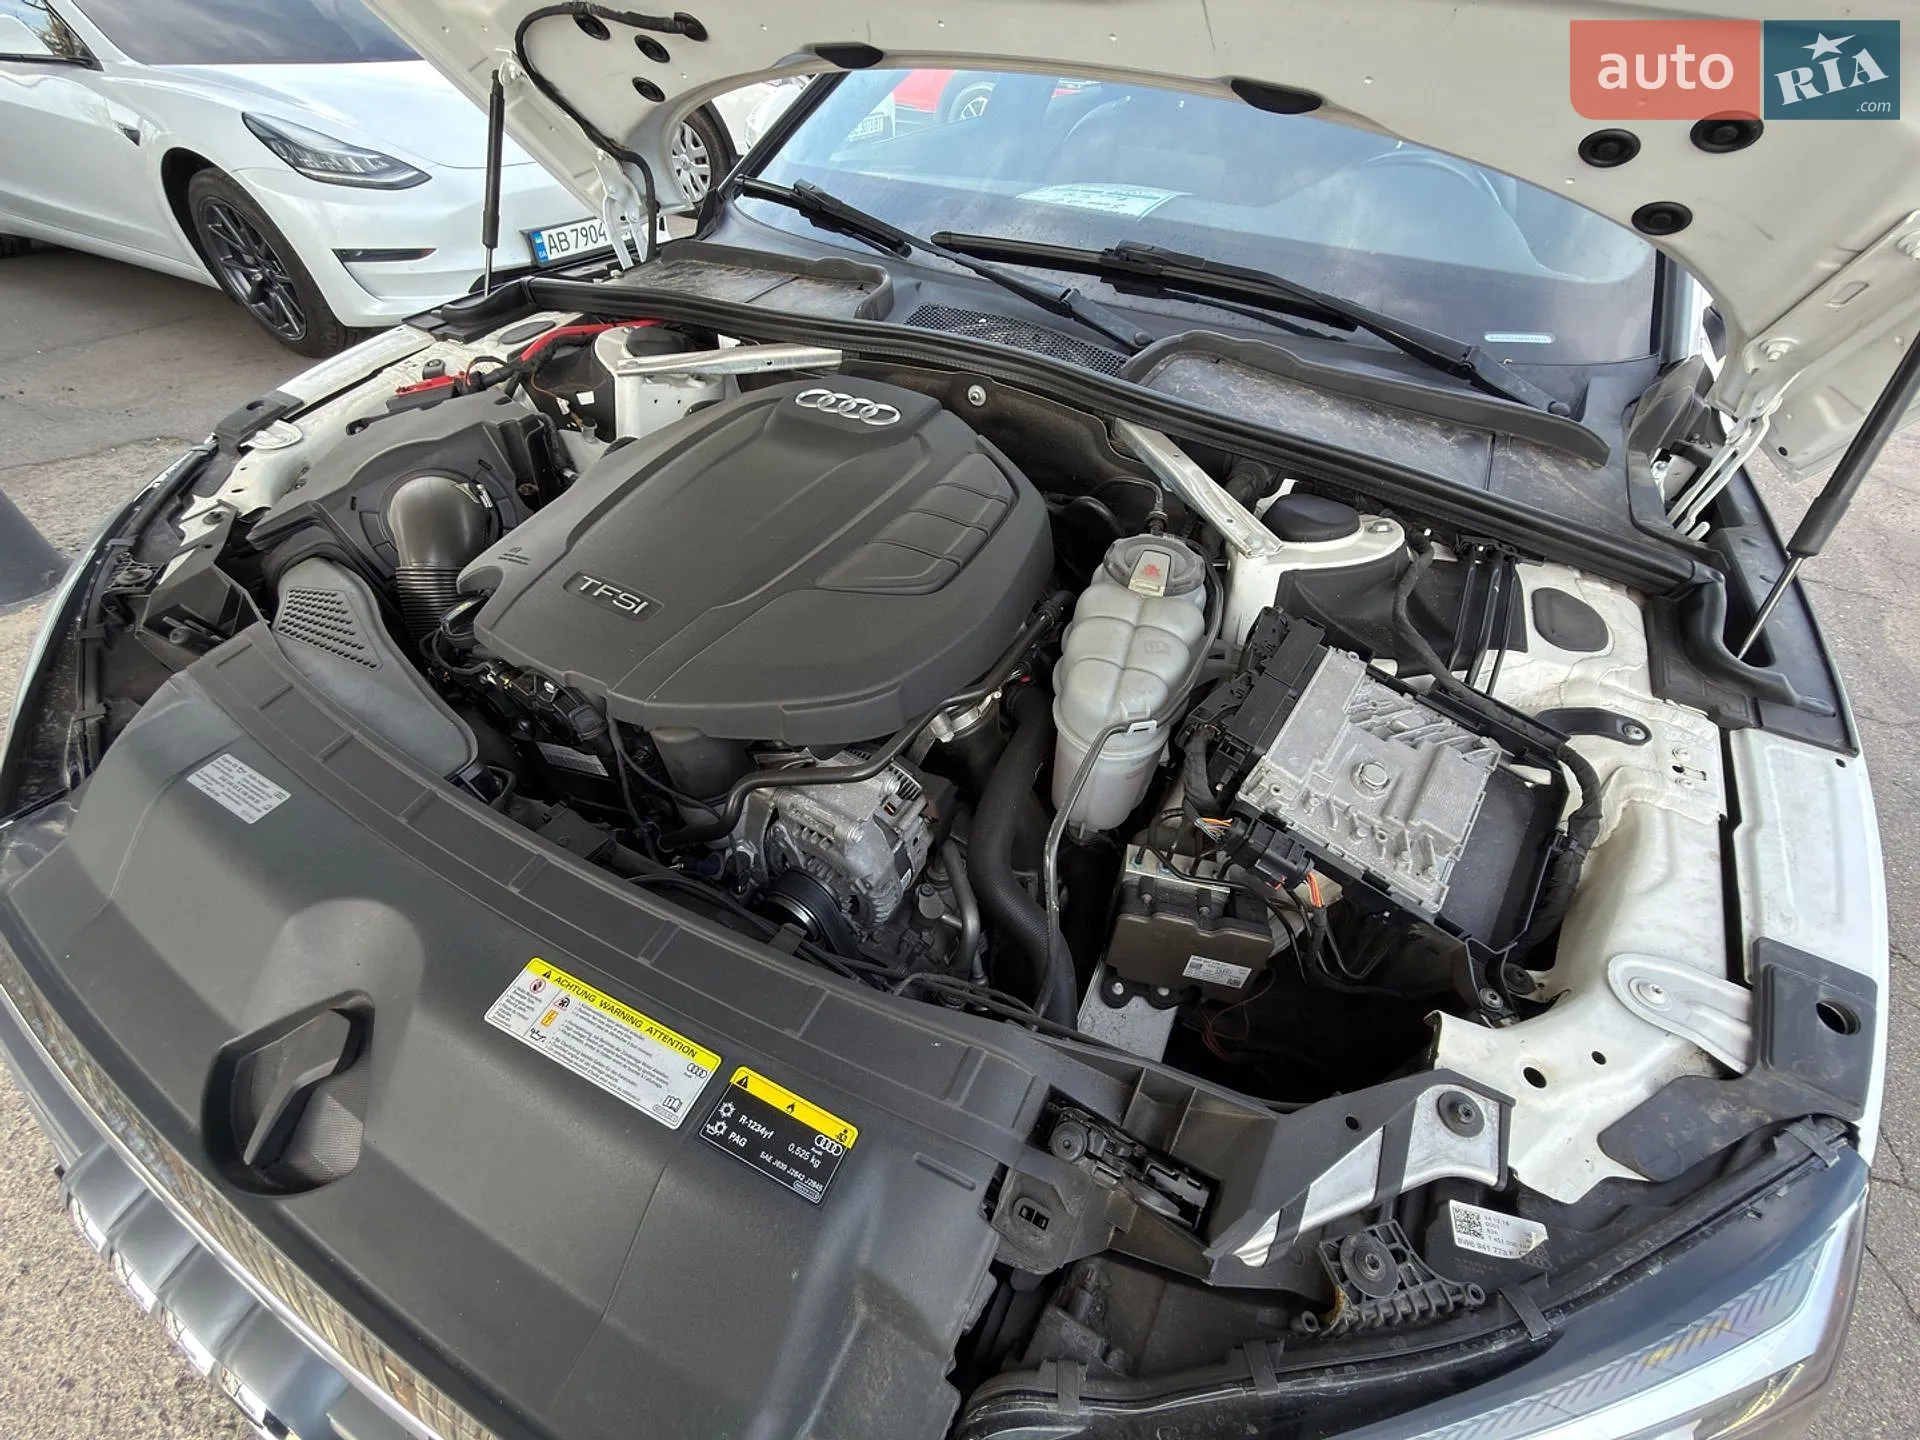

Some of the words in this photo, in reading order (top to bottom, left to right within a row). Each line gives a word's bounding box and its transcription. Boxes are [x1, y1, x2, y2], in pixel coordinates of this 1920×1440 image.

[547, 231, 571, 255] AB
[580, 576, 648, 615] TFSI
[555, 977, 597, 1003] ACHTUNG
[598, 1000, 643, 1028] WARNING
[645, 1026, 698, 1058] ATTENTION
[728, 1131, 748, 1147] PAG
[738, 1114, 775, 1140] R-1234yf
[810, 1153, 822, 1168] kg
